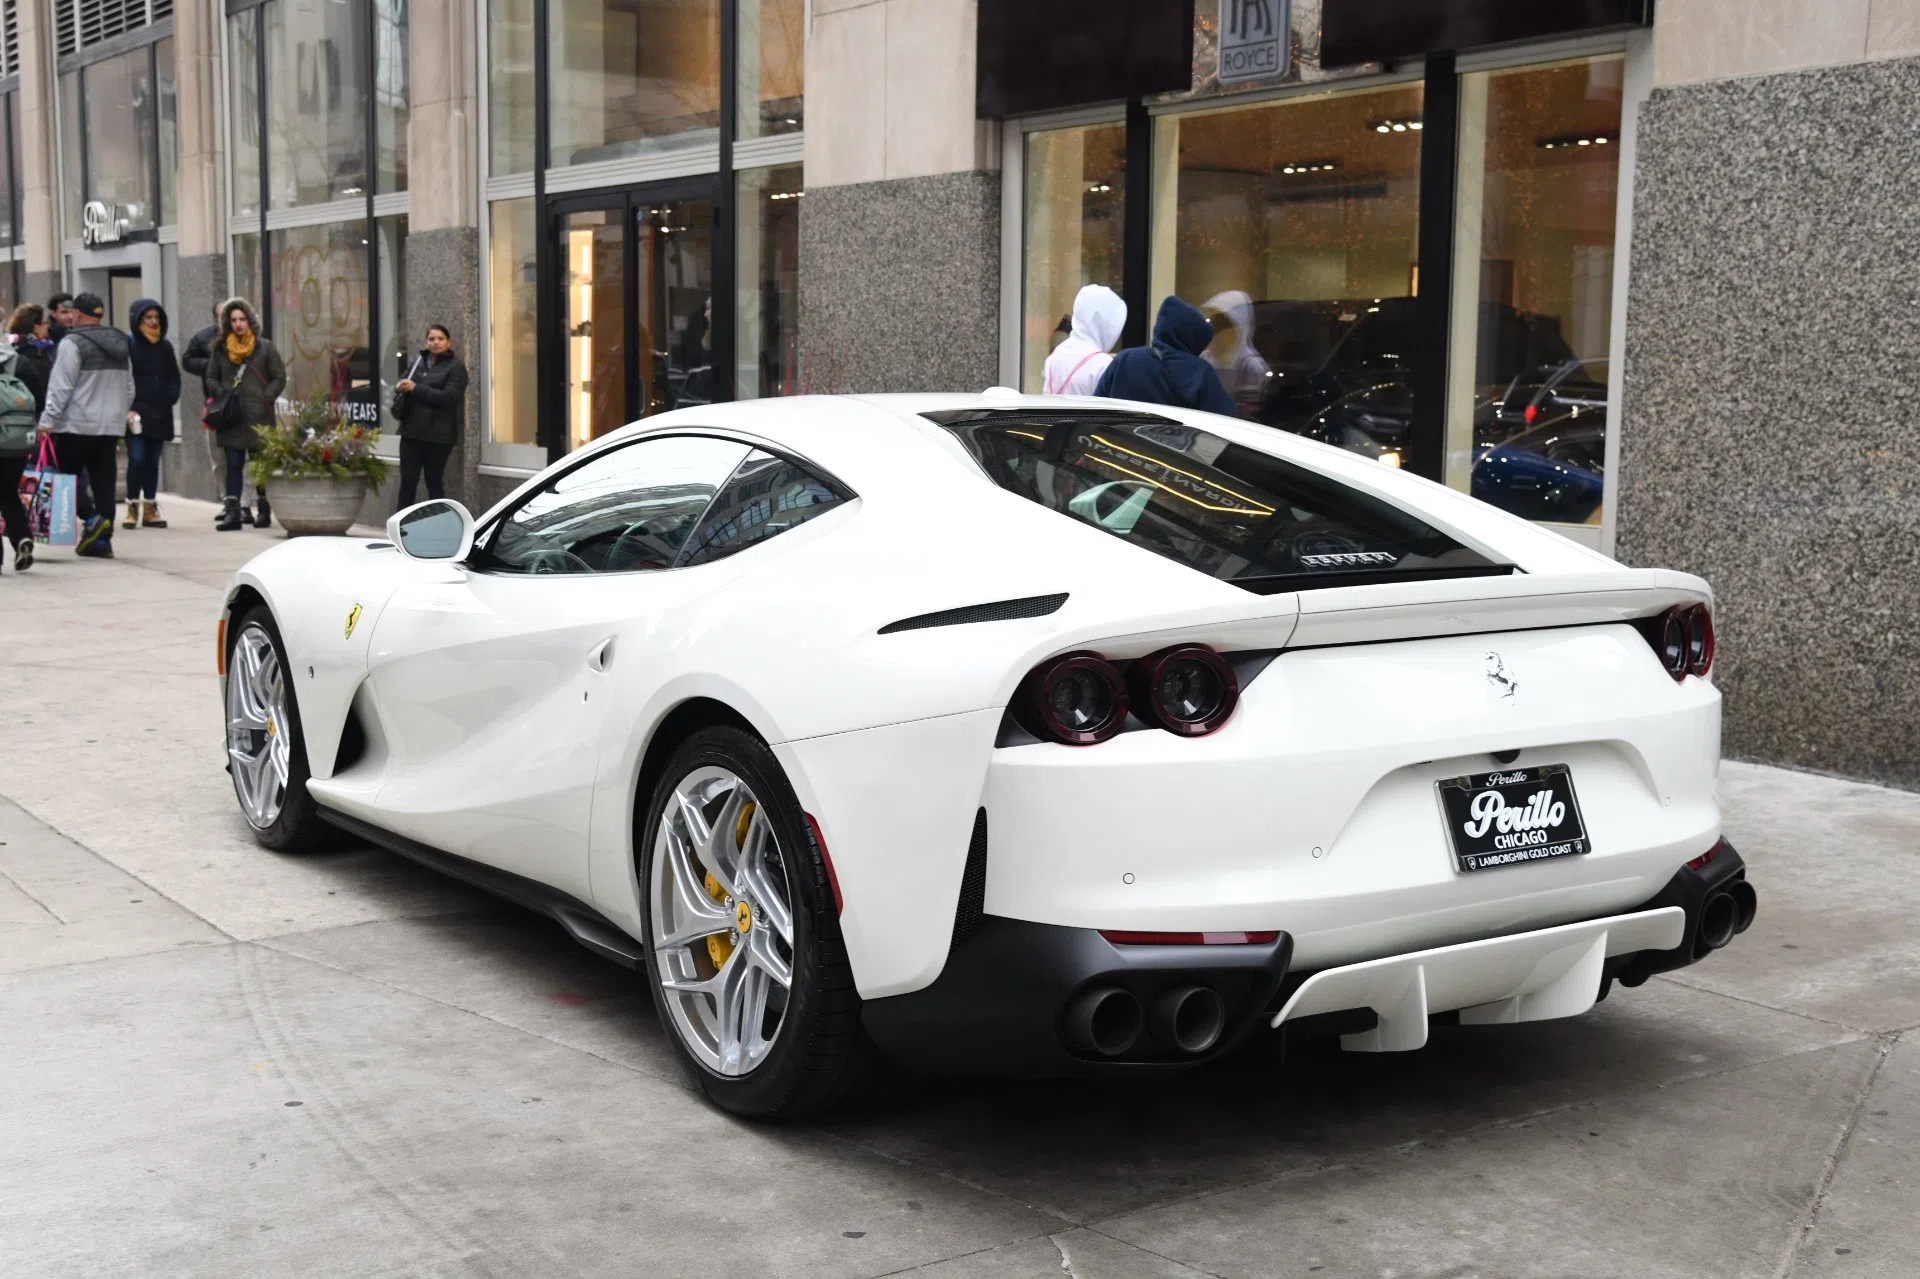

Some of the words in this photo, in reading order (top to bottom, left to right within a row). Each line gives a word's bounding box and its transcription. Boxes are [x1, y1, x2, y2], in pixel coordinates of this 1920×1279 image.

[1224, 46, 1275, 71] ROYCE
[1486, 771, 1527, 786] Perillo
[1464, 790, 1565, 838] Perillo
[1494, 829, 1547, 849] CHICAGO
[1479, 853, 1529, 867] LAMBORGHINI
[1529, 847, 1549, 859] GOLD
[1549, 844, 1572, 855] COAST
